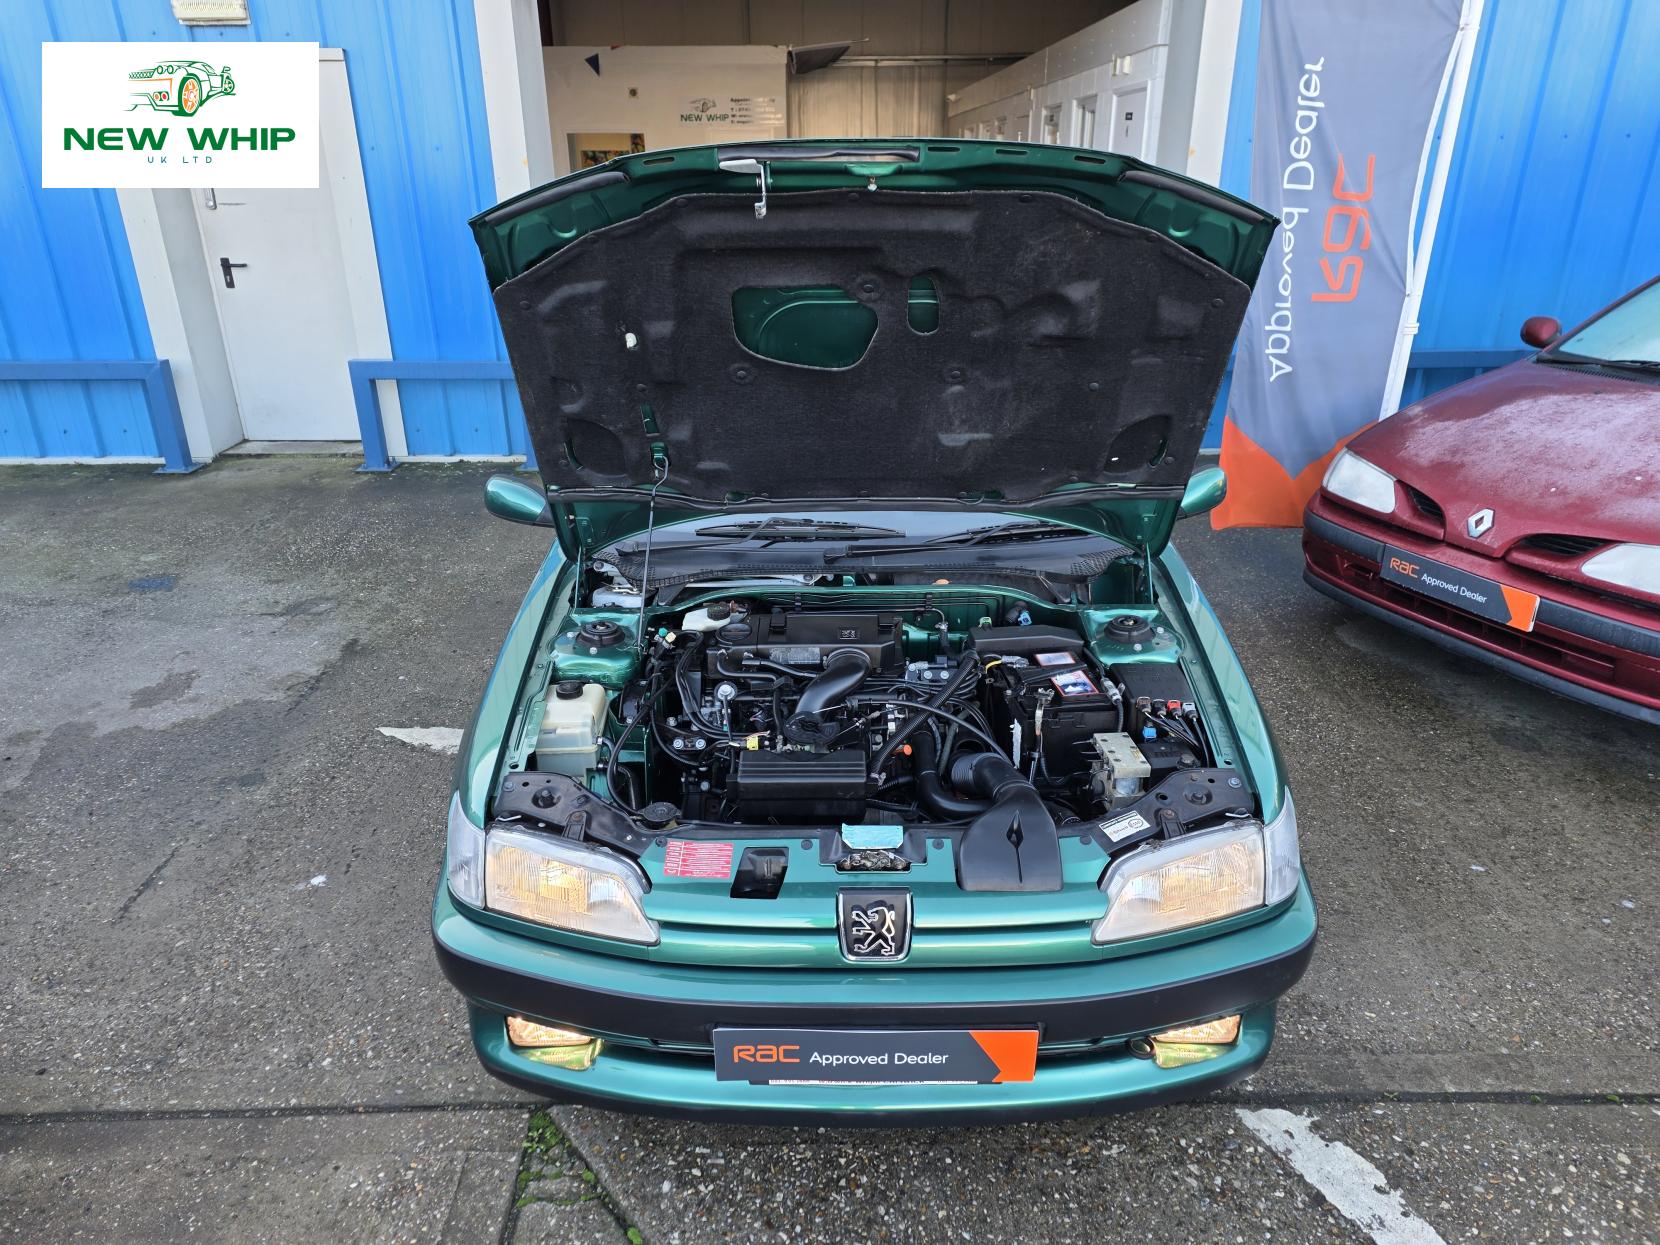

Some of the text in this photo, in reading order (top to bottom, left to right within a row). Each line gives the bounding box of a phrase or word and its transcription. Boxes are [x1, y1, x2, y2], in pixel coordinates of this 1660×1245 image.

[680, 113, 702, 122] NEW
[706, 113, 729, 122] WHIP
[1421, 572, 1459, 594] Approved
[1459, 586, 1488, 604] Dealer
[809, 1051, 888, 1067] Approved
[894, 1052, 949, 1065] Dealer
